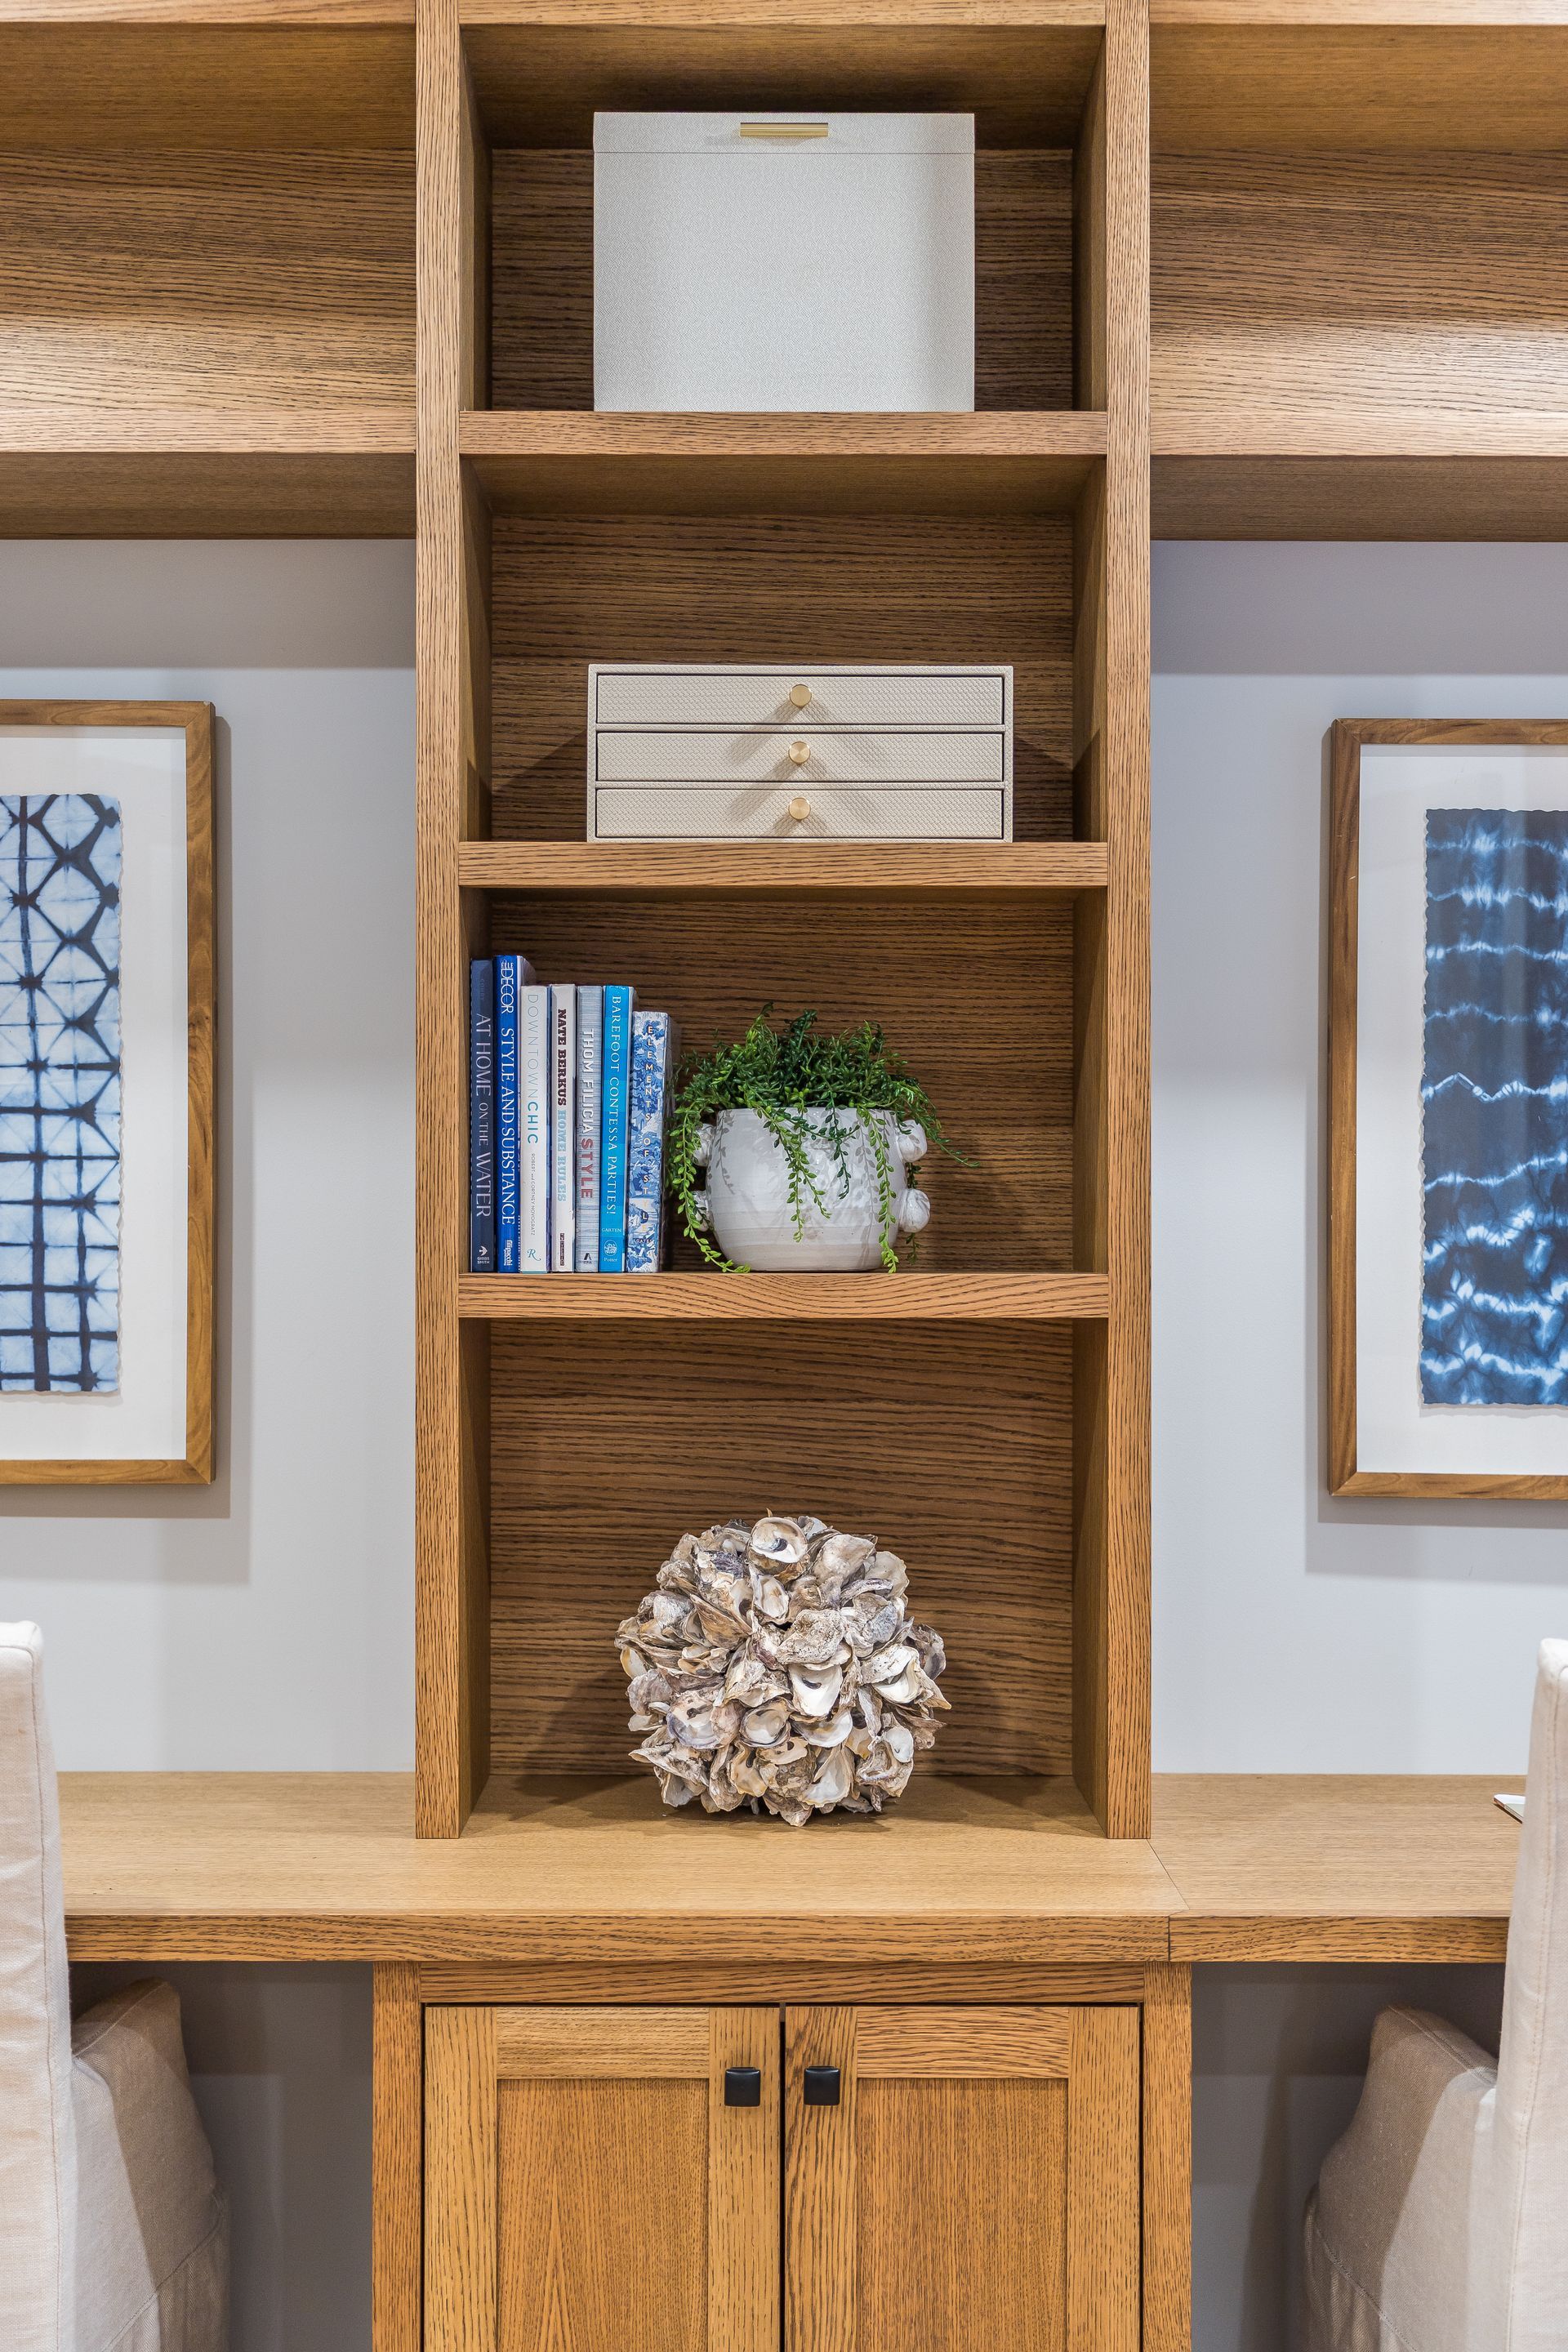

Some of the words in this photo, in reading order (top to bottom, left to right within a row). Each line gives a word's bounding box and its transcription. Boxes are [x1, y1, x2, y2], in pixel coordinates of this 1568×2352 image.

[501, 969, 514, 1014] DECOR
[476, 1013, 491, 1036] AT
[557, 1009, 567, 1045] NATE
[583, 1029, 595, 1072] THOM
[610, 996, 621, 1071] BAREFOOT
[476, 1043, 492, 1096] HOME
[501, 1028, 514, 1082] STYLE
[557, 1049, 567, 1106] BERKUS
[645, 1026, 653, 1120] ELEMENTS
[479, 1102, 488, 1120] ON
[501, 1086, 514, 1124] AND
[557, 1110, 567, 1152] HOME
[581, 1079, 595, 1134] FILICIA
[608, 1076, 619, 1151] CONTESSA
[479, 1123, 488, 1147] THE
[643, 1138, 651, 1157] OF
[476, 1152, 491, 1217] WATER
[501, 1128, 515, 1225] SUBSTANCE
[557, 1156, 567, 1202] RULES
[581, 1138, 594, 1198] STYLE
[606, 1156, 617, 1214] PARTIES!
